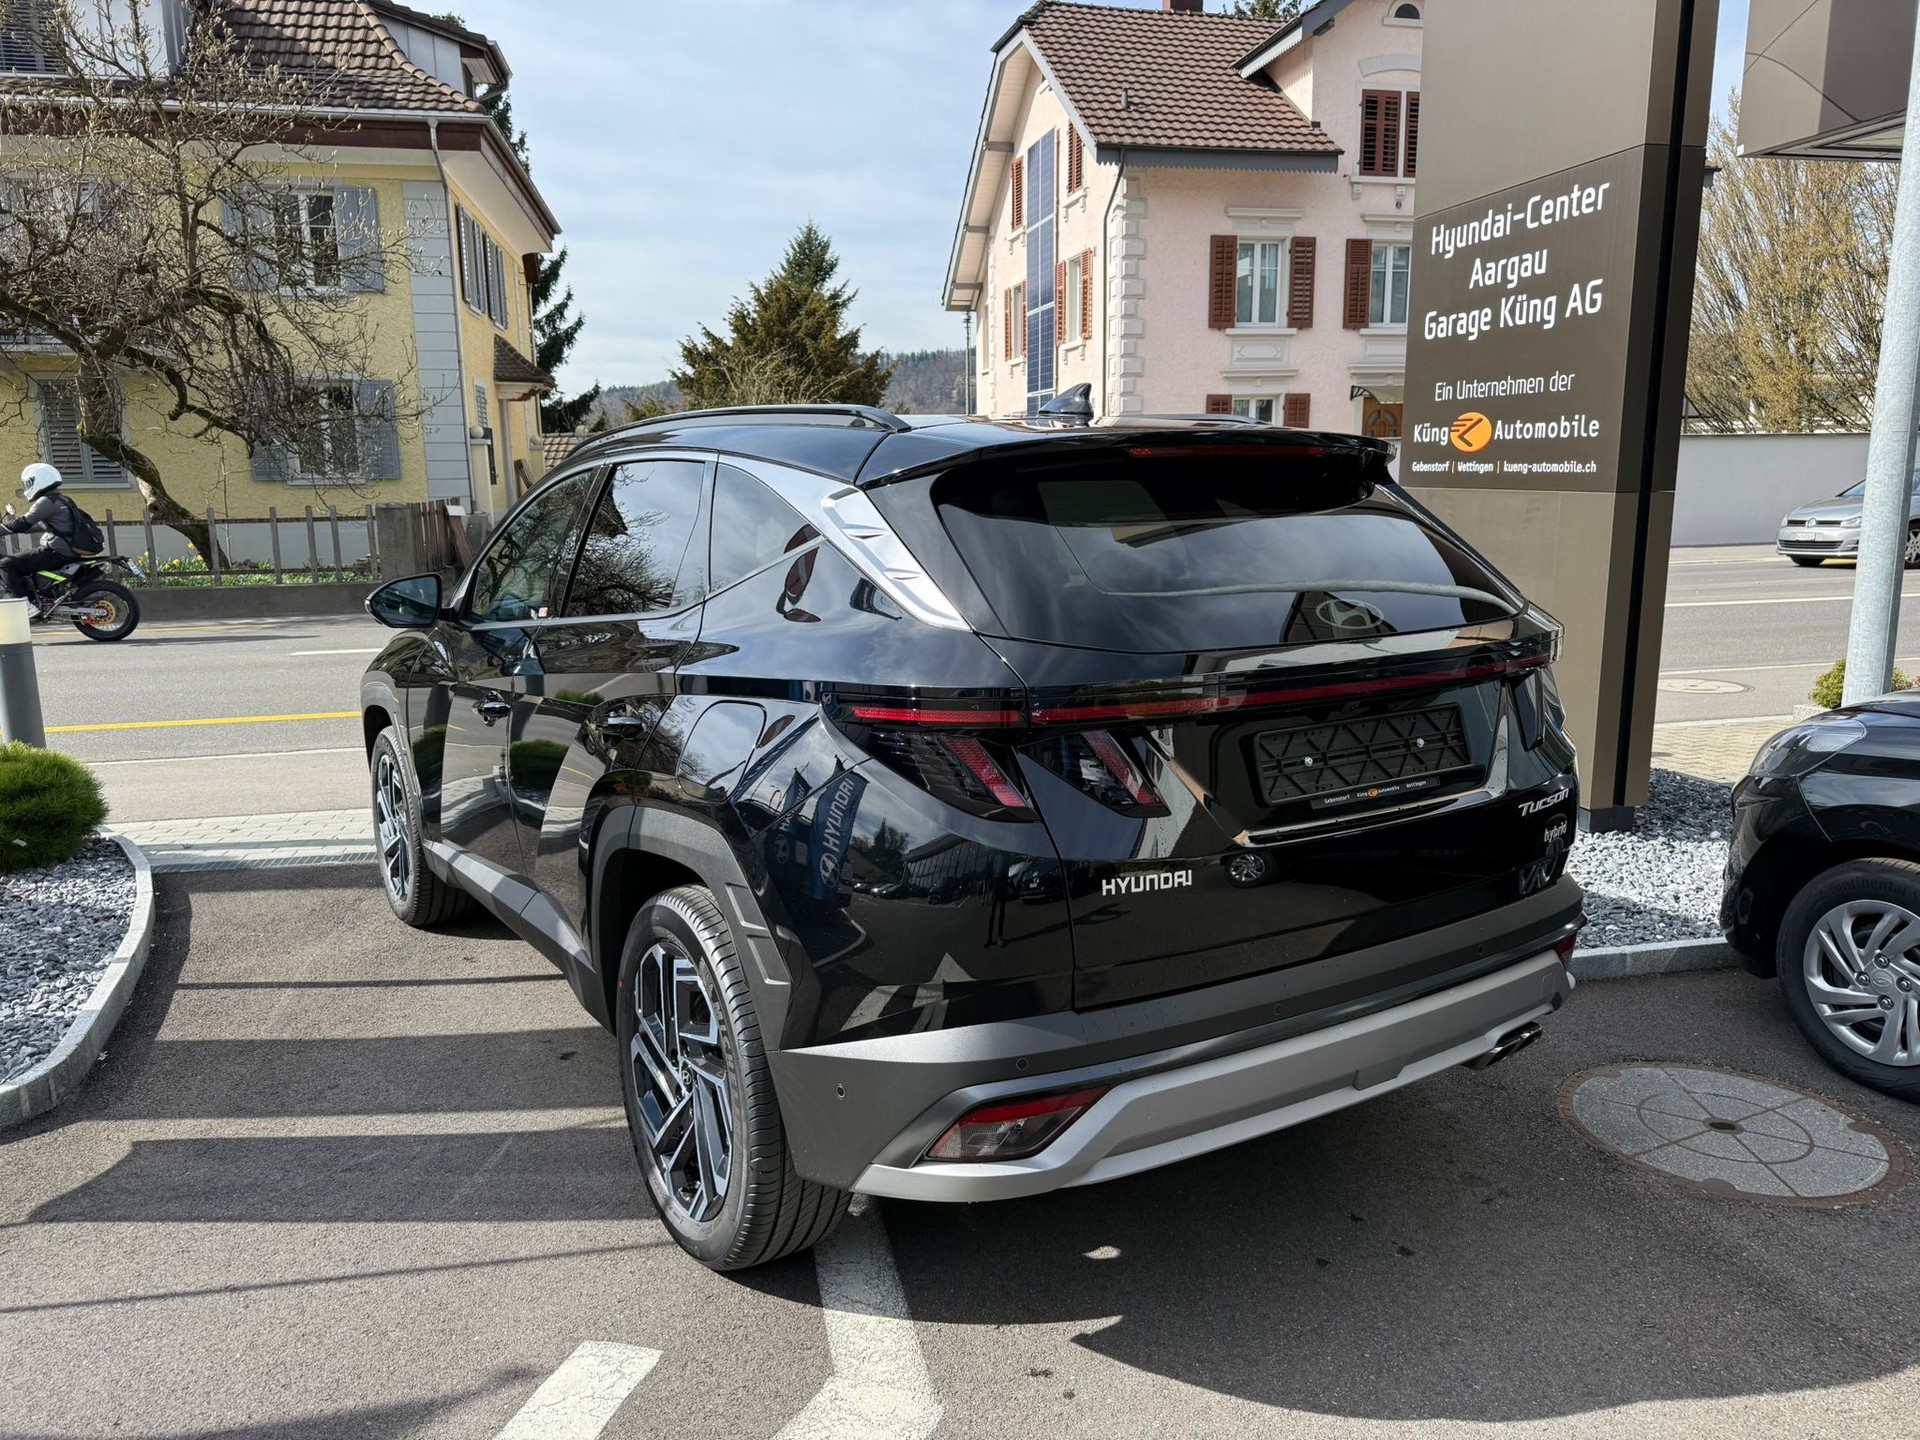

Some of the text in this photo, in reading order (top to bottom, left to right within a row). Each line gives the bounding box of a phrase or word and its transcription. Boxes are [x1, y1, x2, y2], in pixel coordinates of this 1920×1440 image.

[1431, 182, 1610, 259] Hyundai-Center
[1468, 248, 1548, 290] Aargau
[1424, 278, 1603, 341] Garage Küng AG
[1434, 370, 1576, 402] Ein Unternehmen der
[1413, 414, 1600, 446] Küng Automobile
[1411, 460, 1597, 475] Gebenstorf Wettingen kueng-automobile.ch
[821, 778, 855, 853] HYUNDAI
[1518, 787, 1570, 817] TUCSON
[1543, 820, 1568, 843] hybrid
[1101, 869, 1193, 896] HYUNDAI
